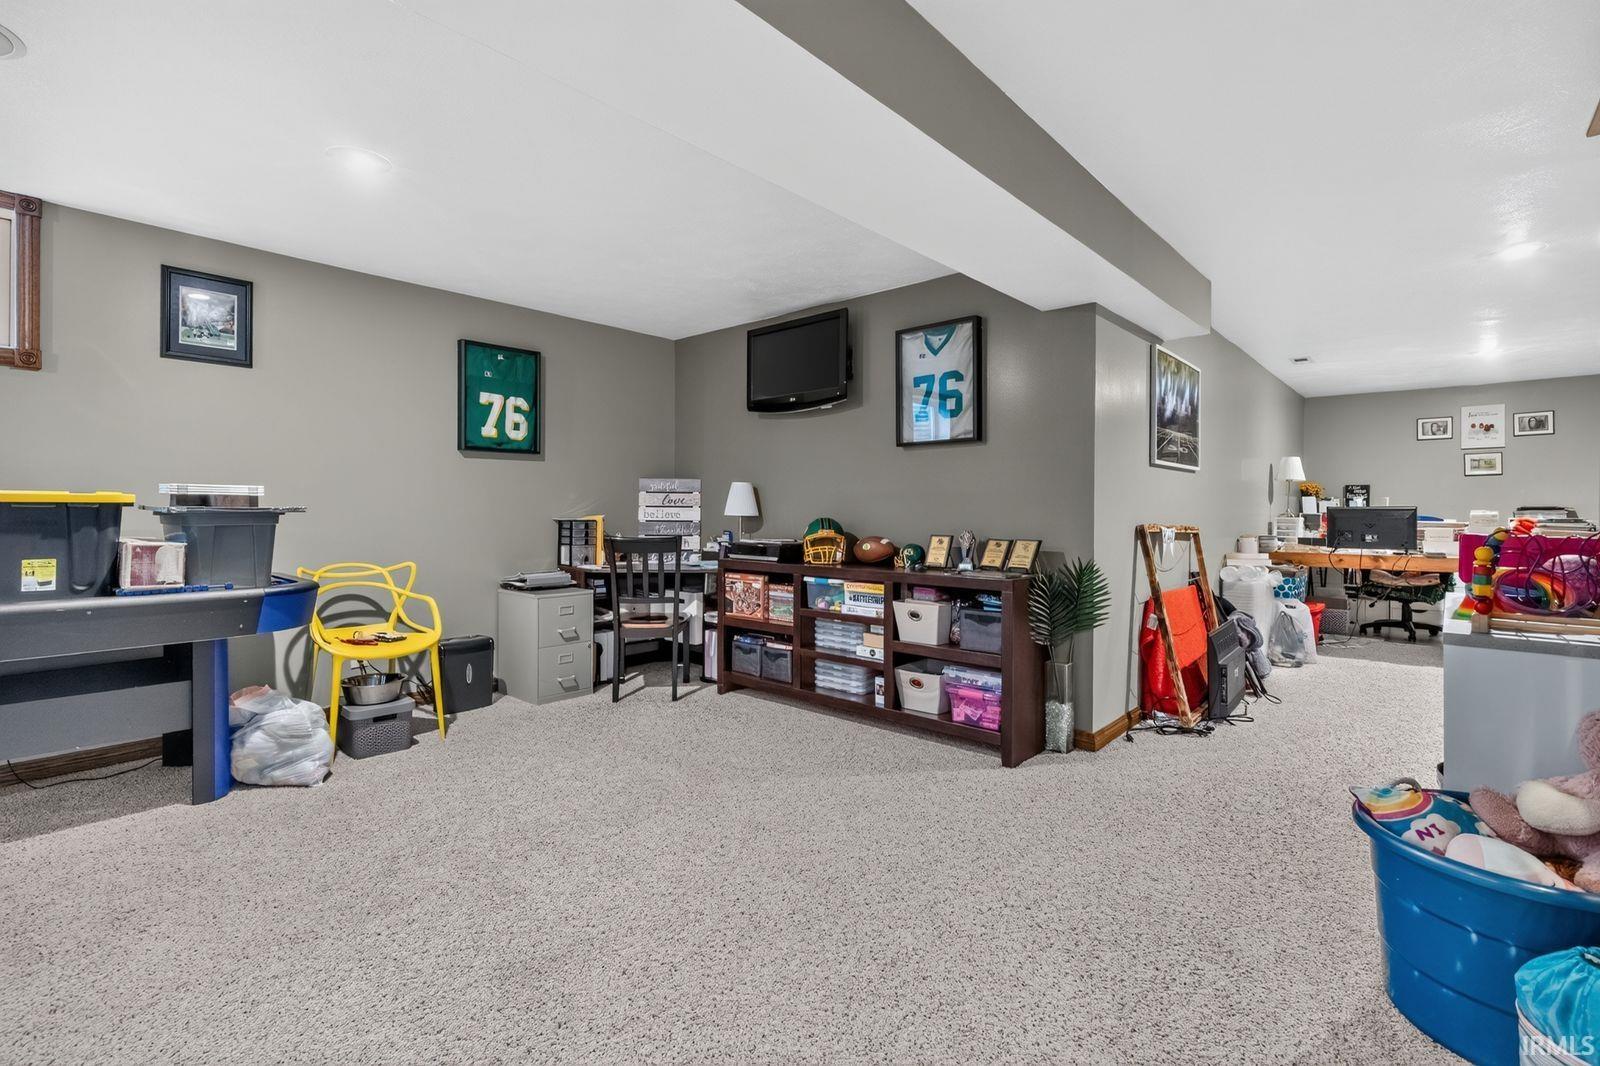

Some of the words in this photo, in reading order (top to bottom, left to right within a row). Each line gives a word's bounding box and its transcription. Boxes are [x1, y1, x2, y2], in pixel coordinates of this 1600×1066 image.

[913, 370, 964, 423] 76
[479, 391, 530, 441] 76
[644, 509, 681, 519] believe
[662, 494, 686, 505] love
